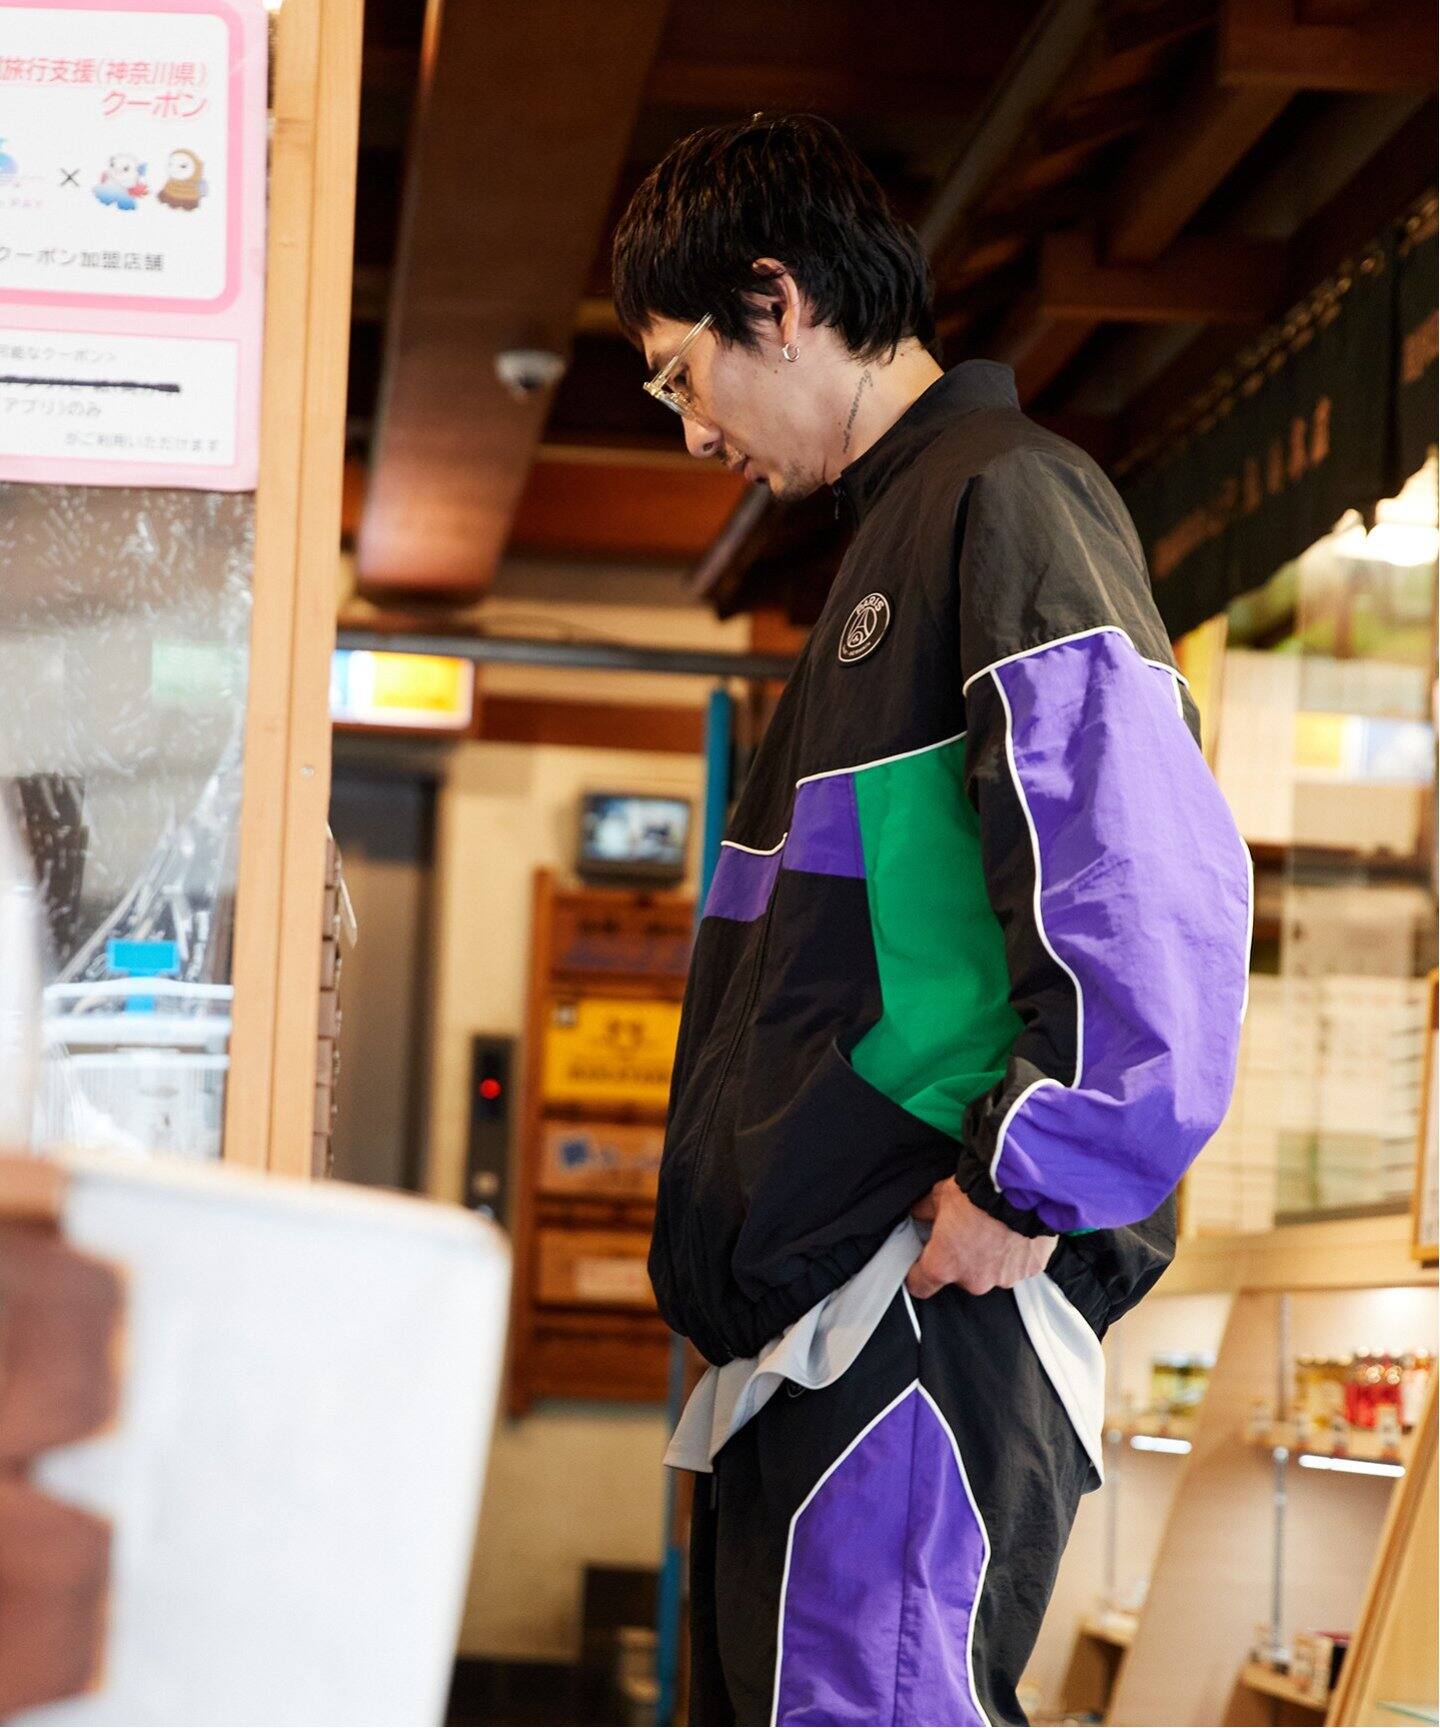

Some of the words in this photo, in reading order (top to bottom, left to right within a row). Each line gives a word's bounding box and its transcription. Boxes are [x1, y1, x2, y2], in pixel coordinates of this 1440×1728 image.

[0, 58, 206, 87] 旅行支援(神奈川県)
[103, 91, 207, 117] クーポン
